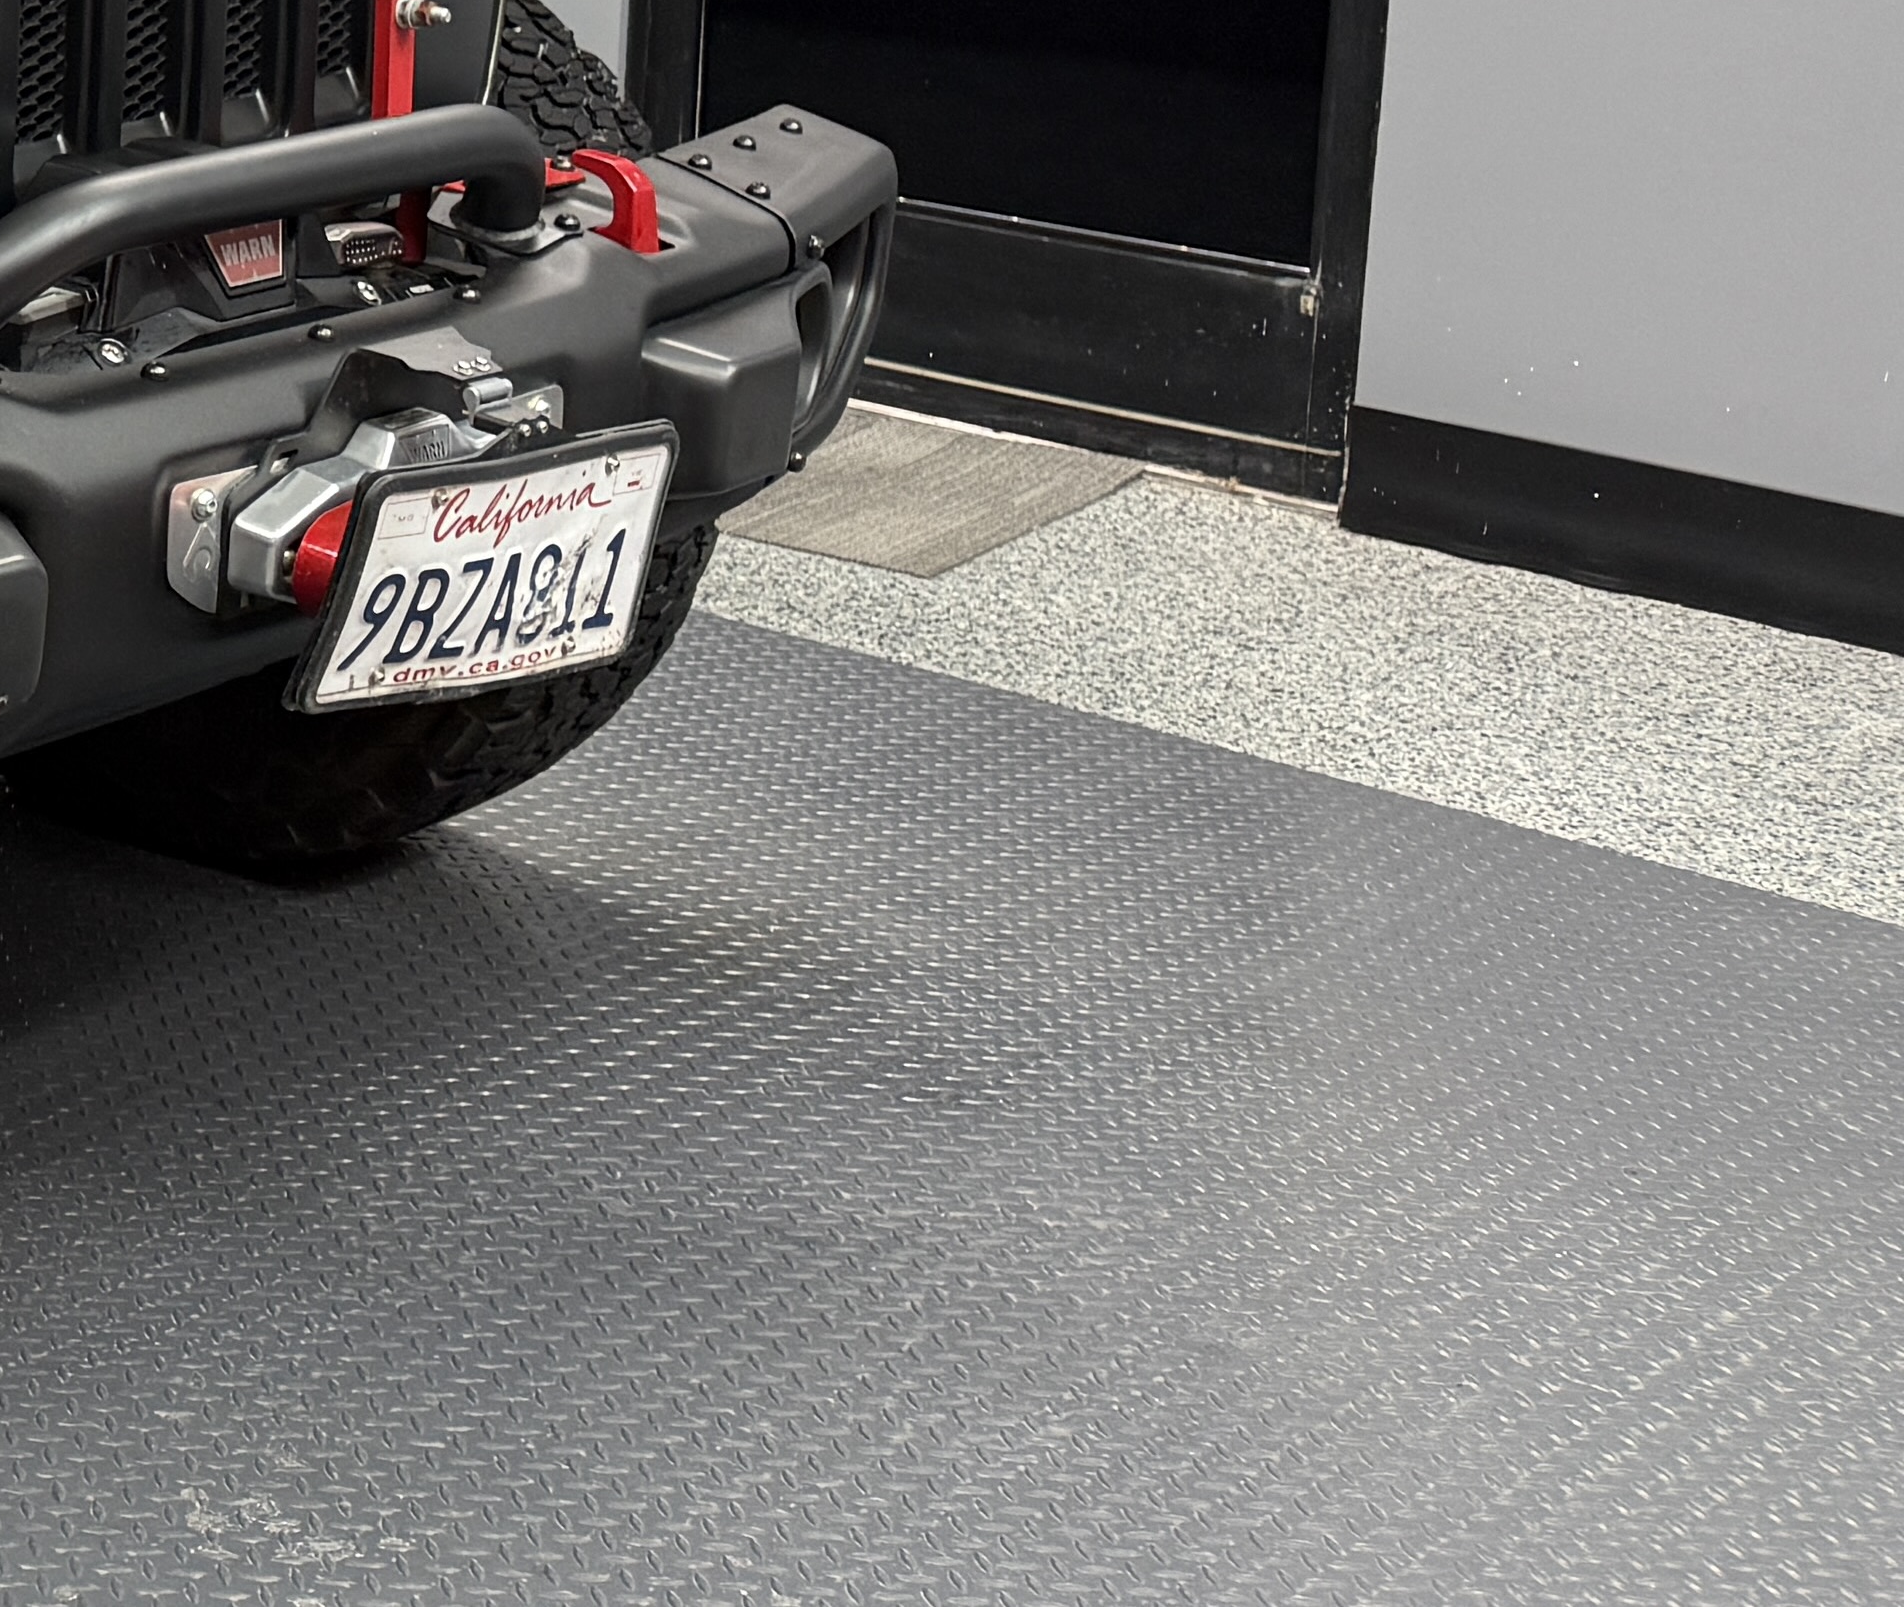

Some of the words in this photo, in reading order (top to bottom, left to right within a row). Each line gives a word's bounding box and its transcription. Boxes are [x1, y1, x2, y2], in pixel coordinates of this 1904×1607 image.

[220, 234, 276, 267] WARN
[433, 476, 612, 548] California
[394, 645, 556, 683] dmv.ca.gov
